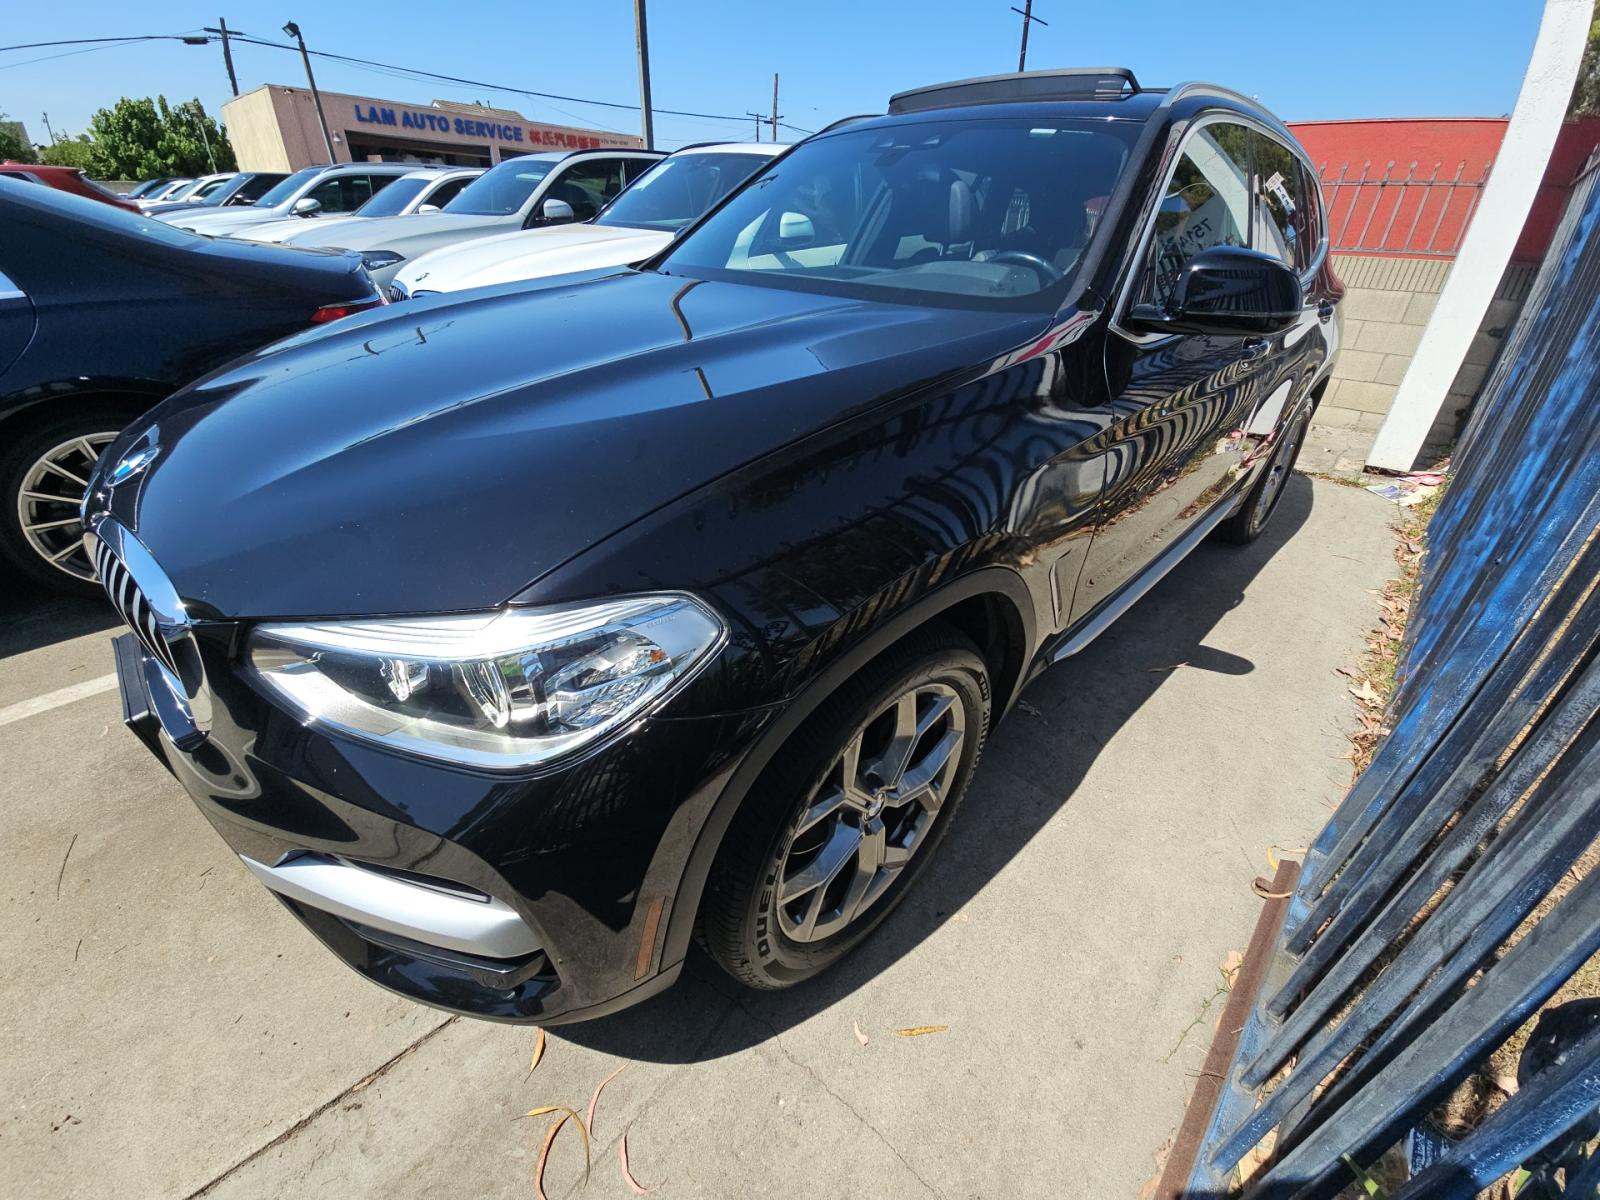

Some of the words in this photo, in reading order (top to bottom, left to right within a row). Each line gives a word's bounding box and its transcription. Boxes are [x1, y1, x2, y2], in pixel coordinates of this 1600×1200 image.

[354, 103, 397, 126] LAM
[401, 110, 450, 132] AUTO
[454, 117, 524, 142] SERVICE
